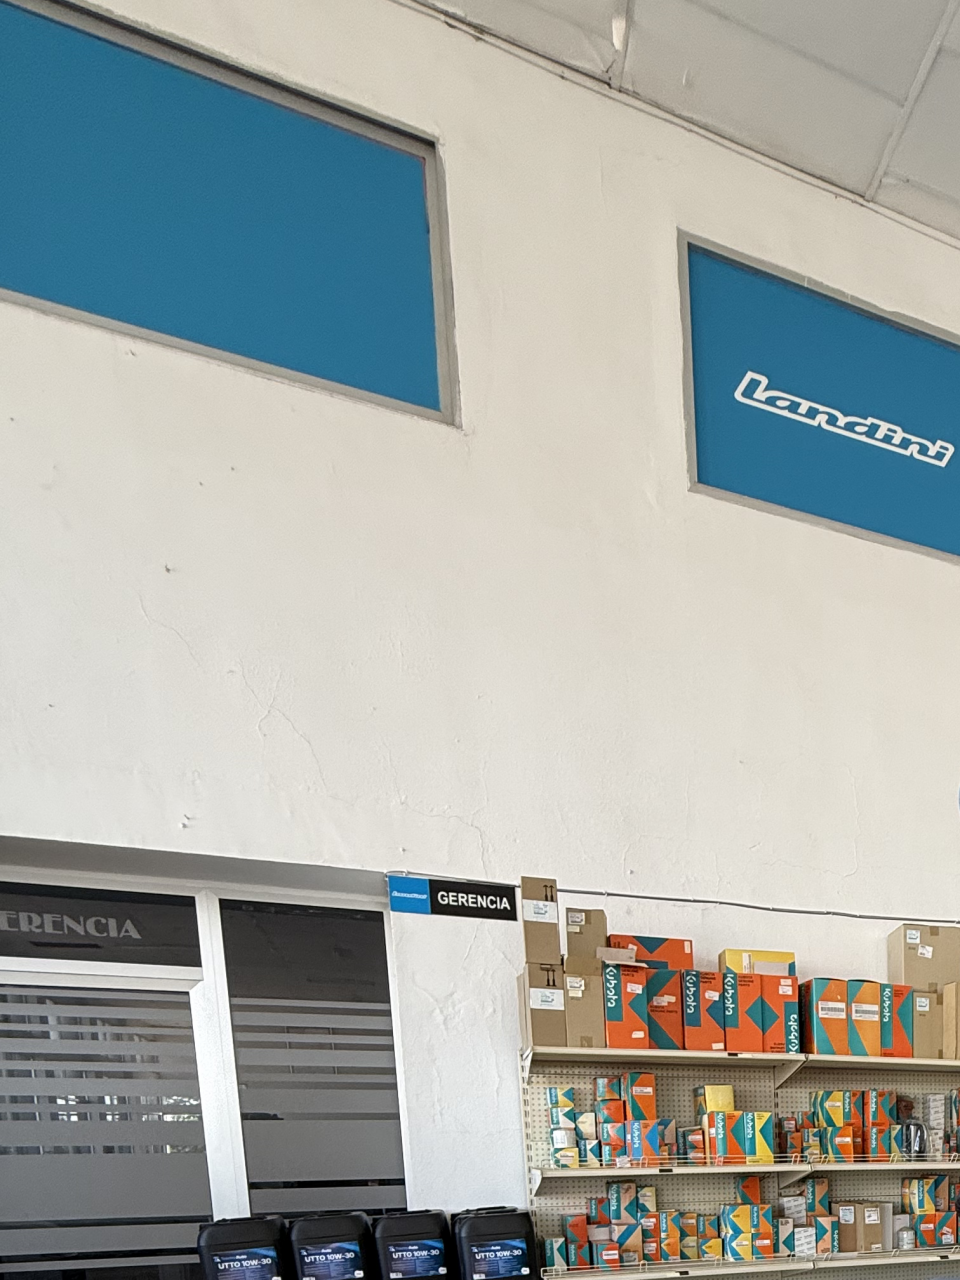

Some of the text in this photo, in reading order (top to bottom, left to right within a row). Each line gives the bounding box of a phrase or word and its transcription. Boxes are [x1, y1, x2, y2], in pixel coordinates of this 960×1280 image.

[437, 890, 511, 911] GERENCIA
[605, 963, 619, 1008] Kubota
[686, 971, 697, 1014] Kubota
[724, 973, 735, 1016] Kubota
[883, 988, 891, 1022] Kubota
[788, 1014, 799, 1054] Kubota
[218, 1261, 241, 1270] UTTO
[242, 1257, 272, 1267] 10W-30
[304, 1254, 325, 1263] UTTO
[326, 1251, 355, 1261] 10W-30
[392, 1250, 412, 1259] UTTO
[413, 1248, 440, 1257] 10W-30
[475, 1249, 522, 1260] UTTO 10W-30
